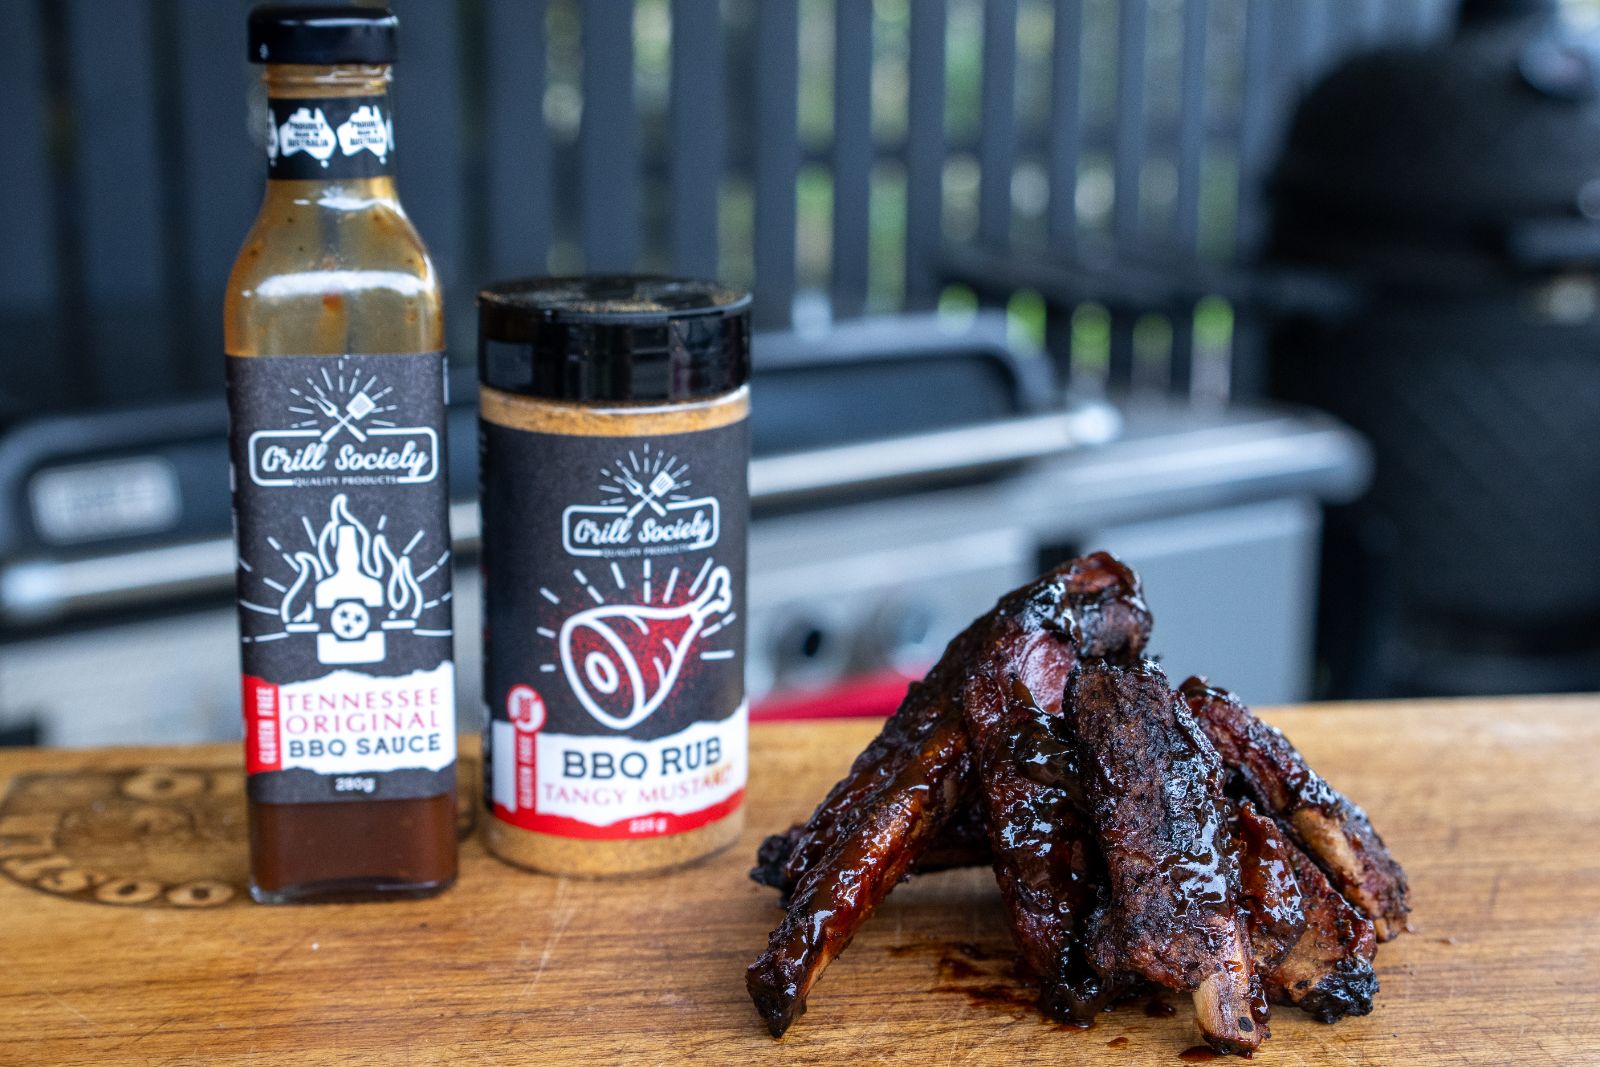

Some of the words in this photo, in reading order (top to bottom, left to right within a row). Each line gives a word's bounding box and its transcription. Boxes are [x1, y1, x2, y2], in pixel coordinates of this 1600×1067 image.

[261, 441, 329, 473] Grill
[335, 440, 429, 477] Society
[294, 476, 338, 487] QUALITY
[341, 475, 398, 486] PRODUCTS
[574, 517, 633, 545] Grill
[638, 510, 711, 543] Society
[284, 687, 439, 712] TENNESSEE
[286, 710, 440, 735] ORIGINAL
[288, 739, 347, 758] BBQ
[356, 733, 441, 756] SAUCE
[562, 750, 648, 780] BBQ
[660, 736, 722, 776] RUB
[543, 783, 626, 806] TANGY
